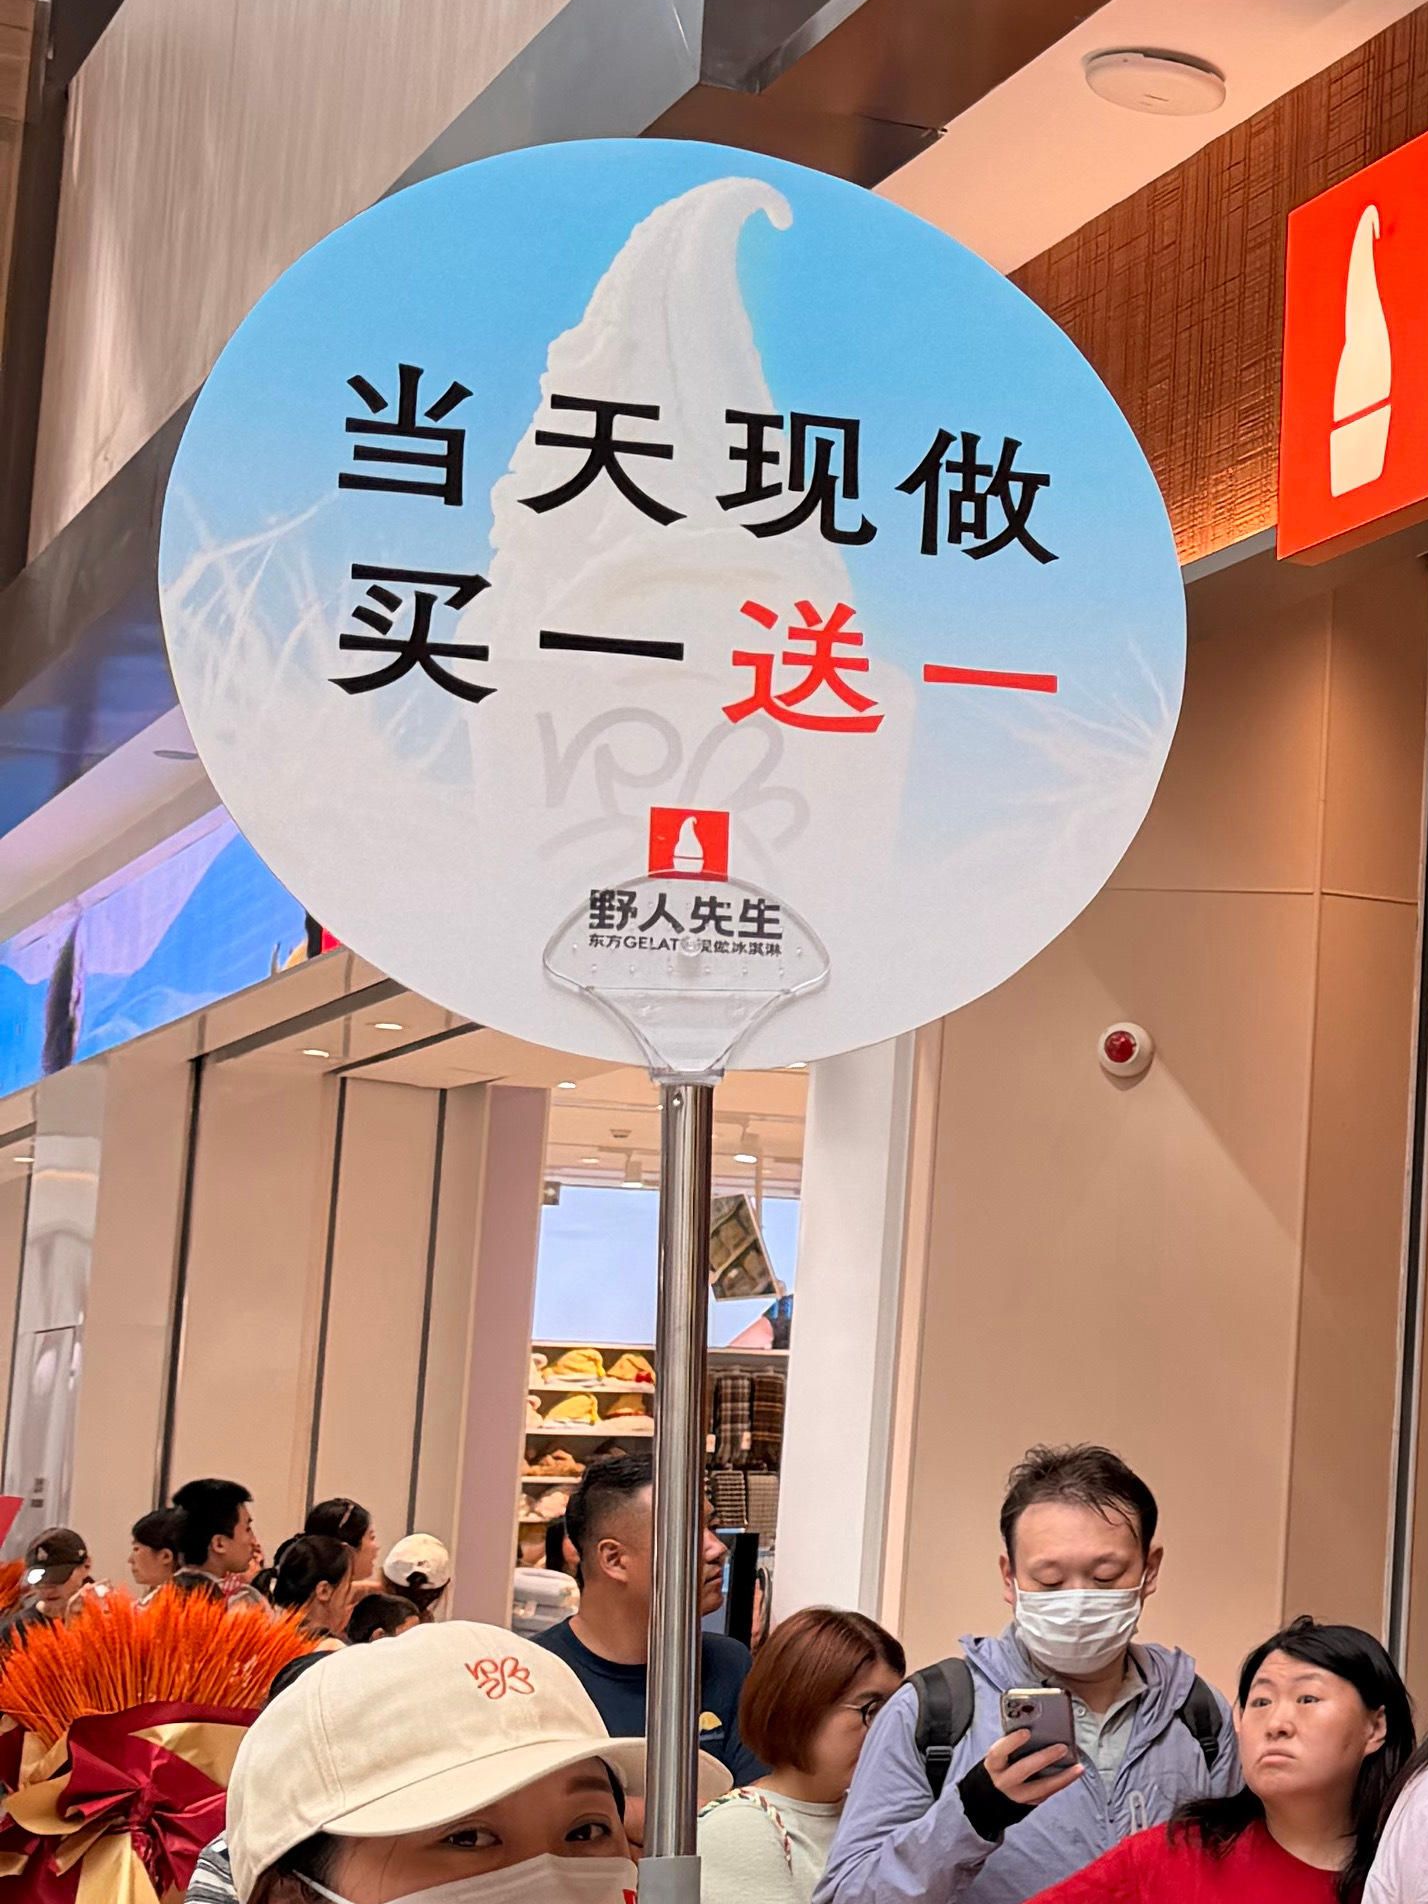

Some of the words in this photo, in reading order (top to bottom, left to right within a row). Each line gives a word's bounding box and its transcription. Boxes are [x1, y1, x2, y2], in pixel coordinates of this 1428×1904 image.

[337, 363, 1060, 565] 当天现做
[329, 562, 1059, 734] 买一送一
[588, 889, 783, 940] 野人先生
